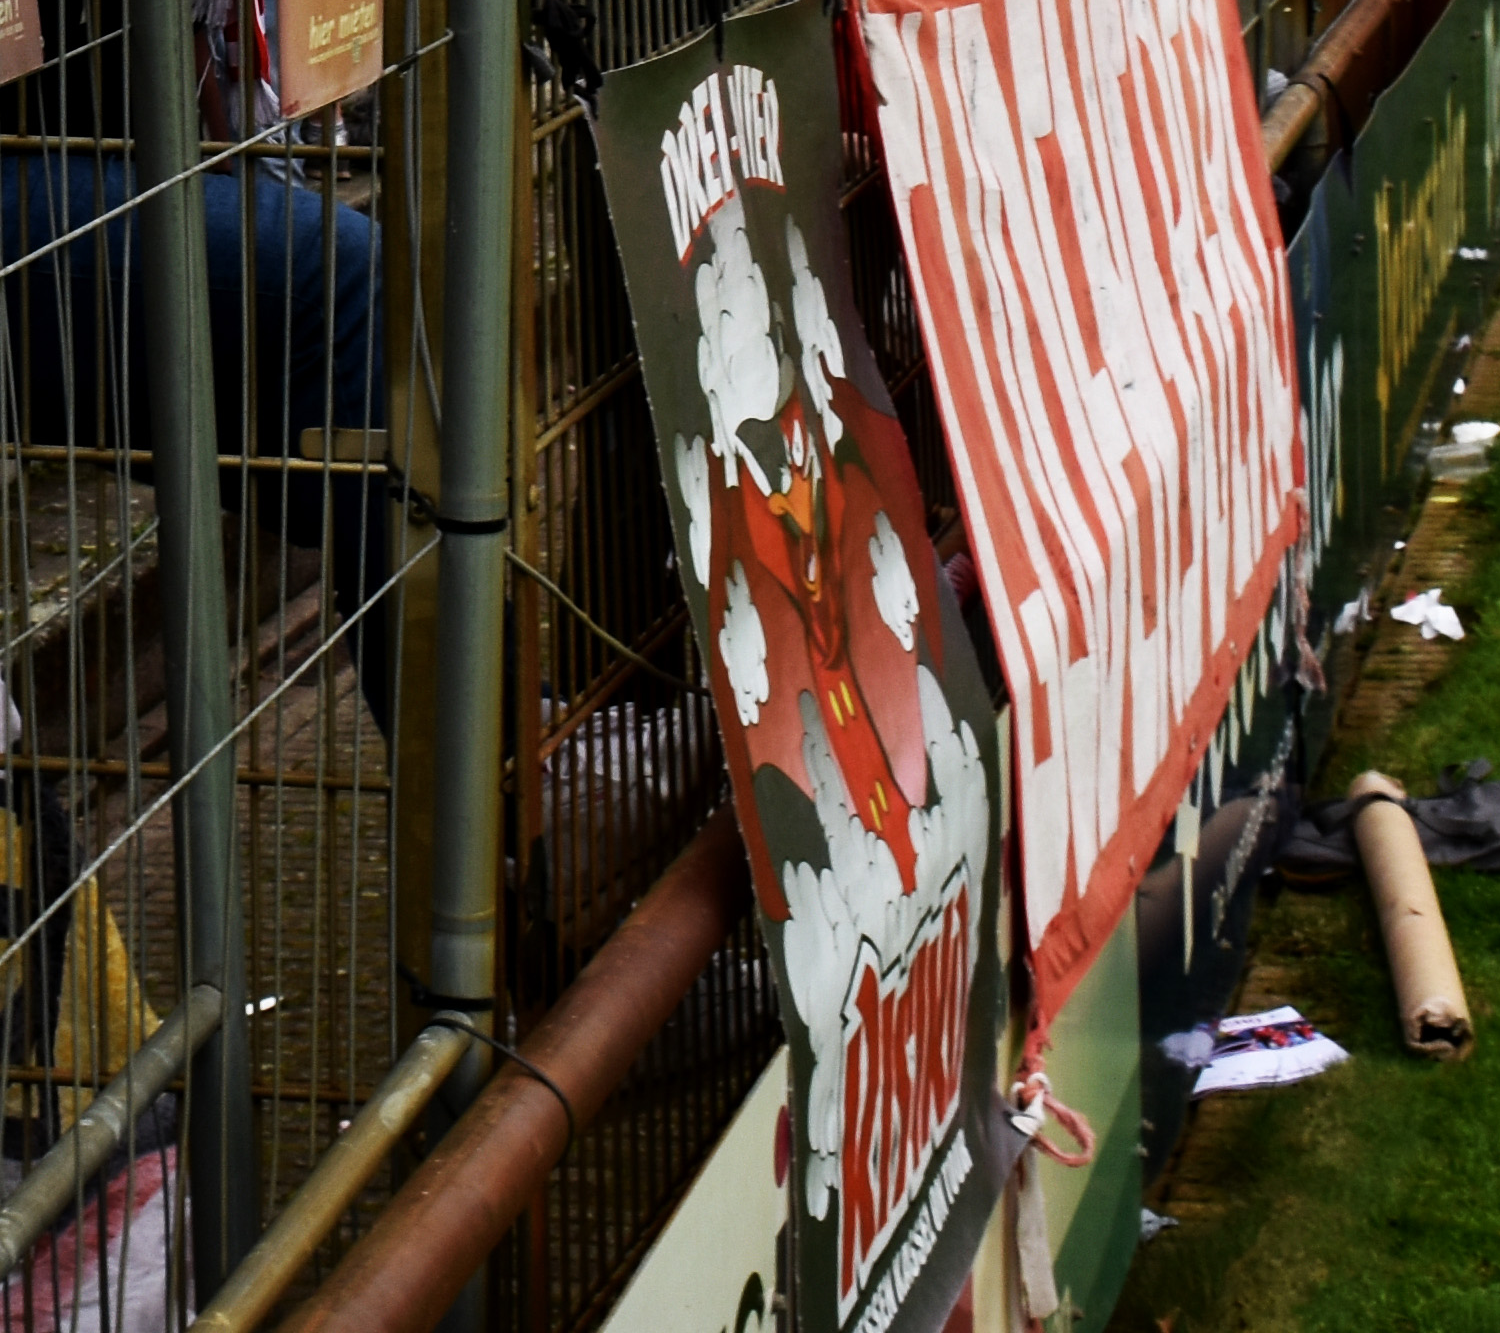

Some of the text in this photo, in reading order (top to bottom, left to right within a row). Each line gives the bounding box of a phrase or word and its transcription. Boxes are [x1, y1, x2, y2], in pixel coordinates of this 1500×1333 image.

[308, 14, 336, 51] hier
[658, 63, 786, 264] DREI-VIER
[840, 879, 970, 1311] RISIKO
